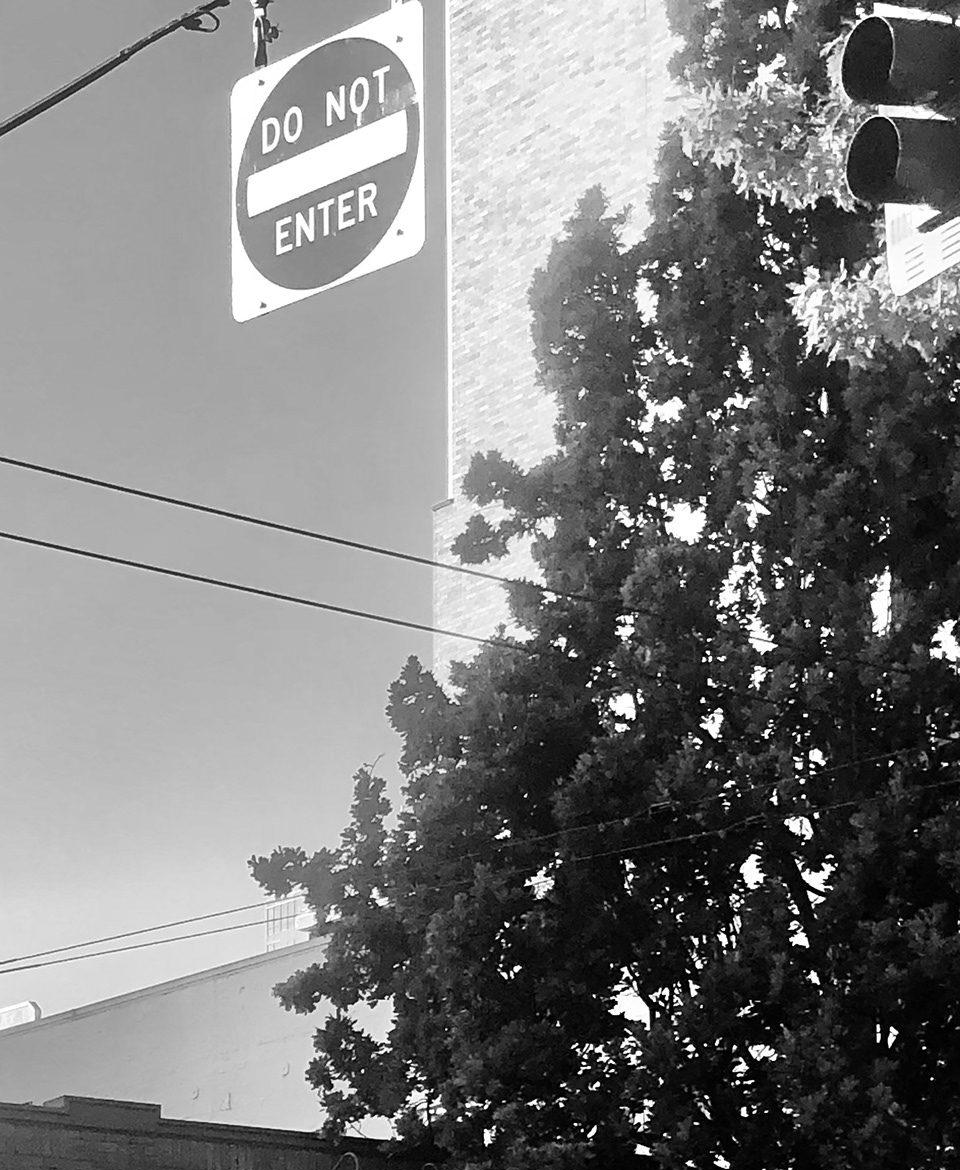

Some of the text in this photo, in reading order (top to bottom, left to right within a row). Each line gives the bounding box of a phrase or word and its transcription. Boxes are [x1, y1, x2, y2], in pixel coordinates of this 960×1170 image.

[261, 65, 390, 155] DO NOT
[275, 182, 378, 256] ENTER
